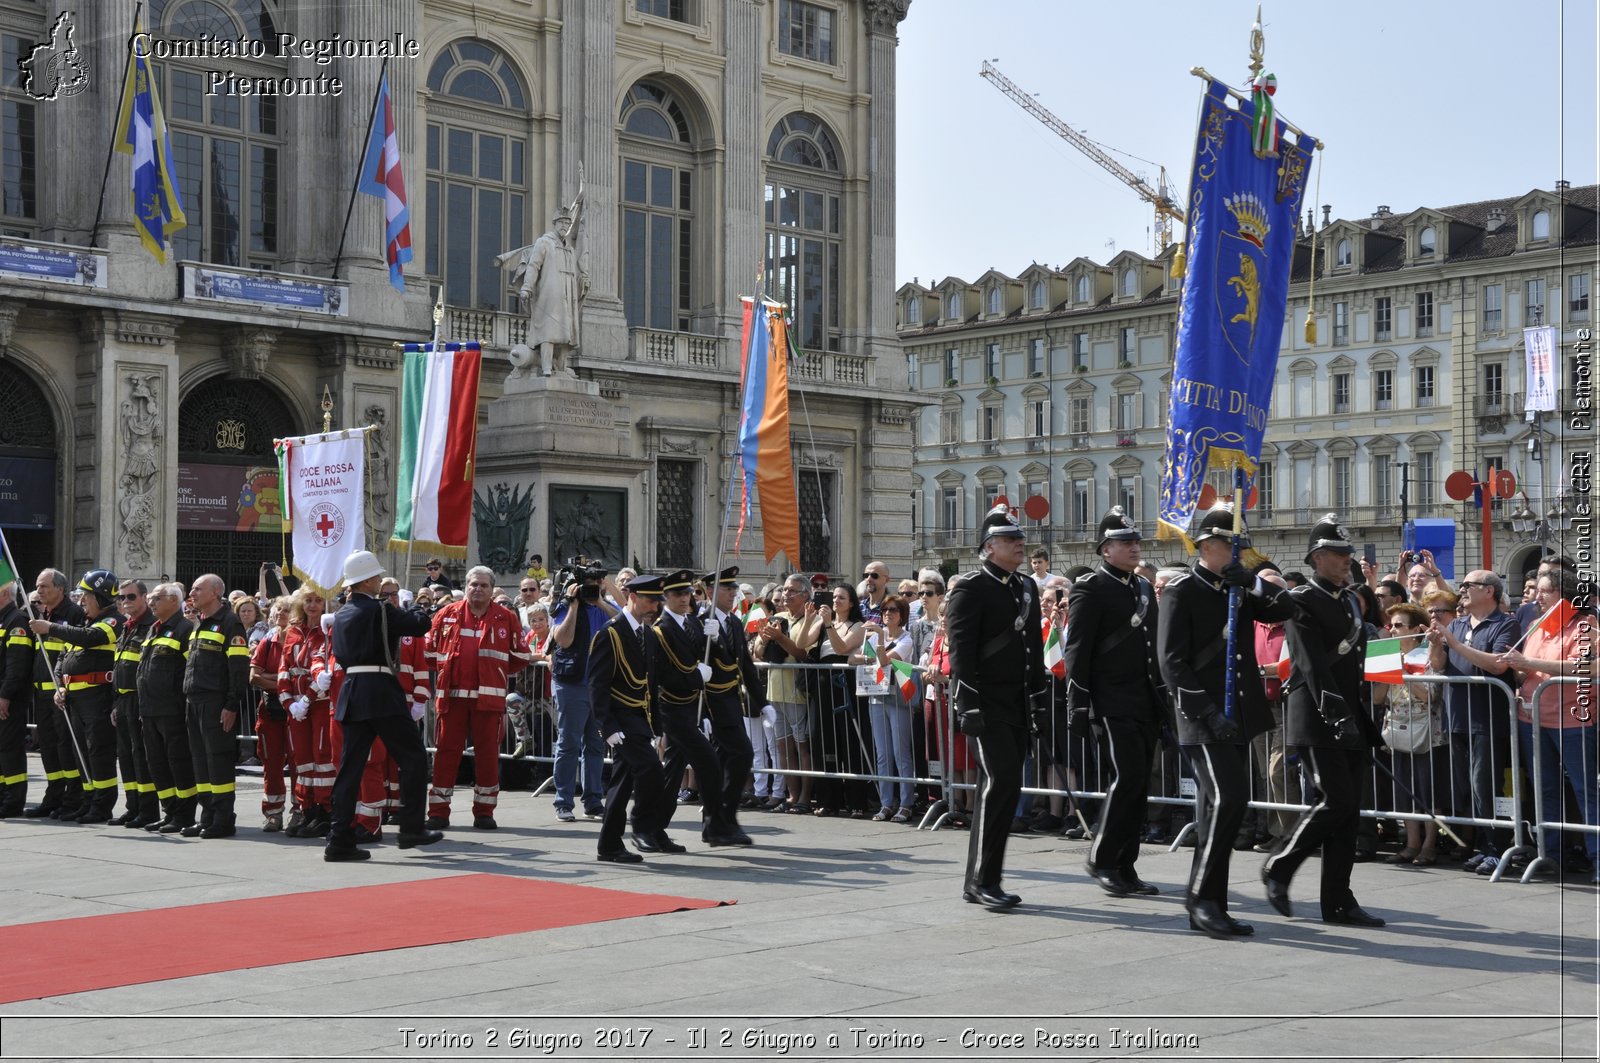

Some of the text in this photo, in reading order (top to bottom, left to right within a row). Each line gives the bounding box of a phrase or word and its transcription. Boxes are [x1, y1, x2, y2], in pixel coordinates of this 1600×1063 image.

[1177, 378, 1265, 431] CITTA' DI INO
[325, 463, 354, 475] ROSSA
[305, 477, 341, 489] ITALIANA
[177, 487, 192, 495] ose
[302, 490, 322, 498] COMITATO
[199, 496, 227, 506] mondi
